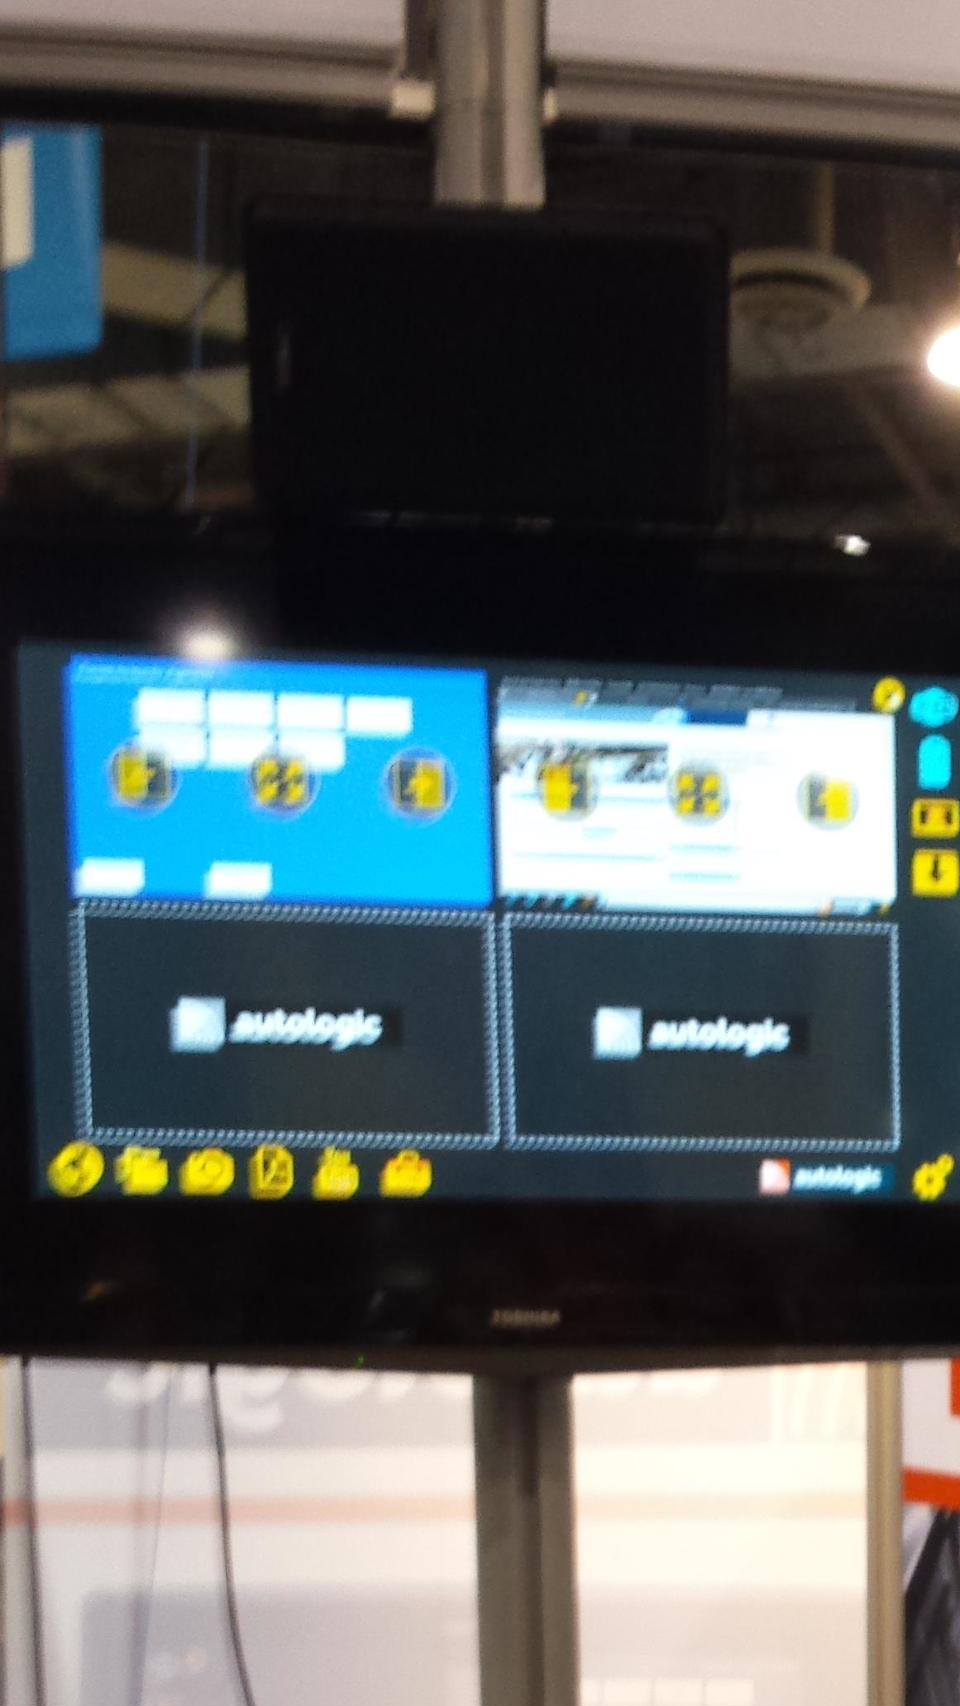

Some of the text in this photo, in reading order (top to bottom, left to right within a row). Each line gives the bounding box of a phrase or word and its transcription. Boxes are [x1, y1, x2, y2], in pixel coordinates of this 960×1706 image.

[230, 1006, 383, 1051] autologic
[648, 1016, 791, 1057] autologic
[793, 1162, 883, 1193] autologic
